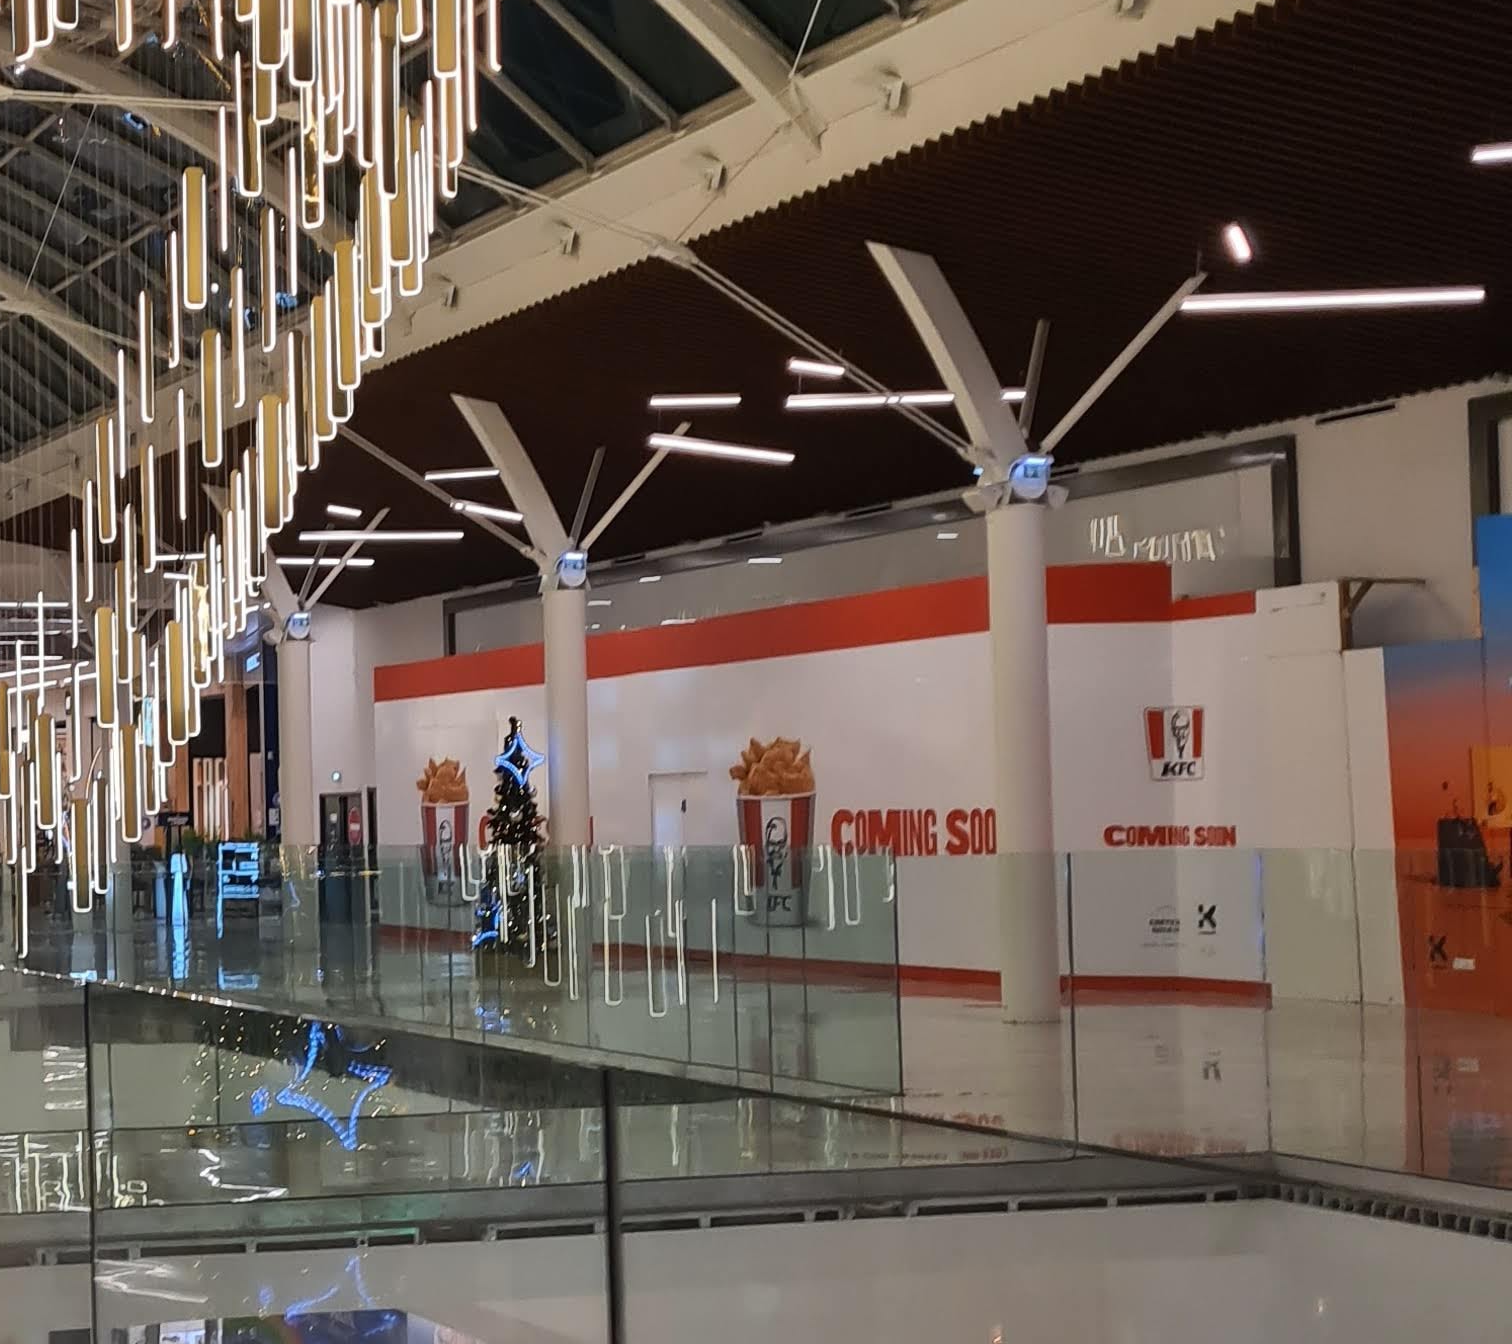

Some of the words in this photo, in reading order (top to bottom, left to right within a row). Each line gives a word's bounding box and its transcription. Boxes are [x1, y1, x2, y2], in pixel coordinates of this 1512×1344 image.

[1161, 761, 1196, 777] KFC
[831, 809, 938, 856] COMING
[945, 808, 997, 855] SOO
[1103, 824, 1190, 847] COMING
